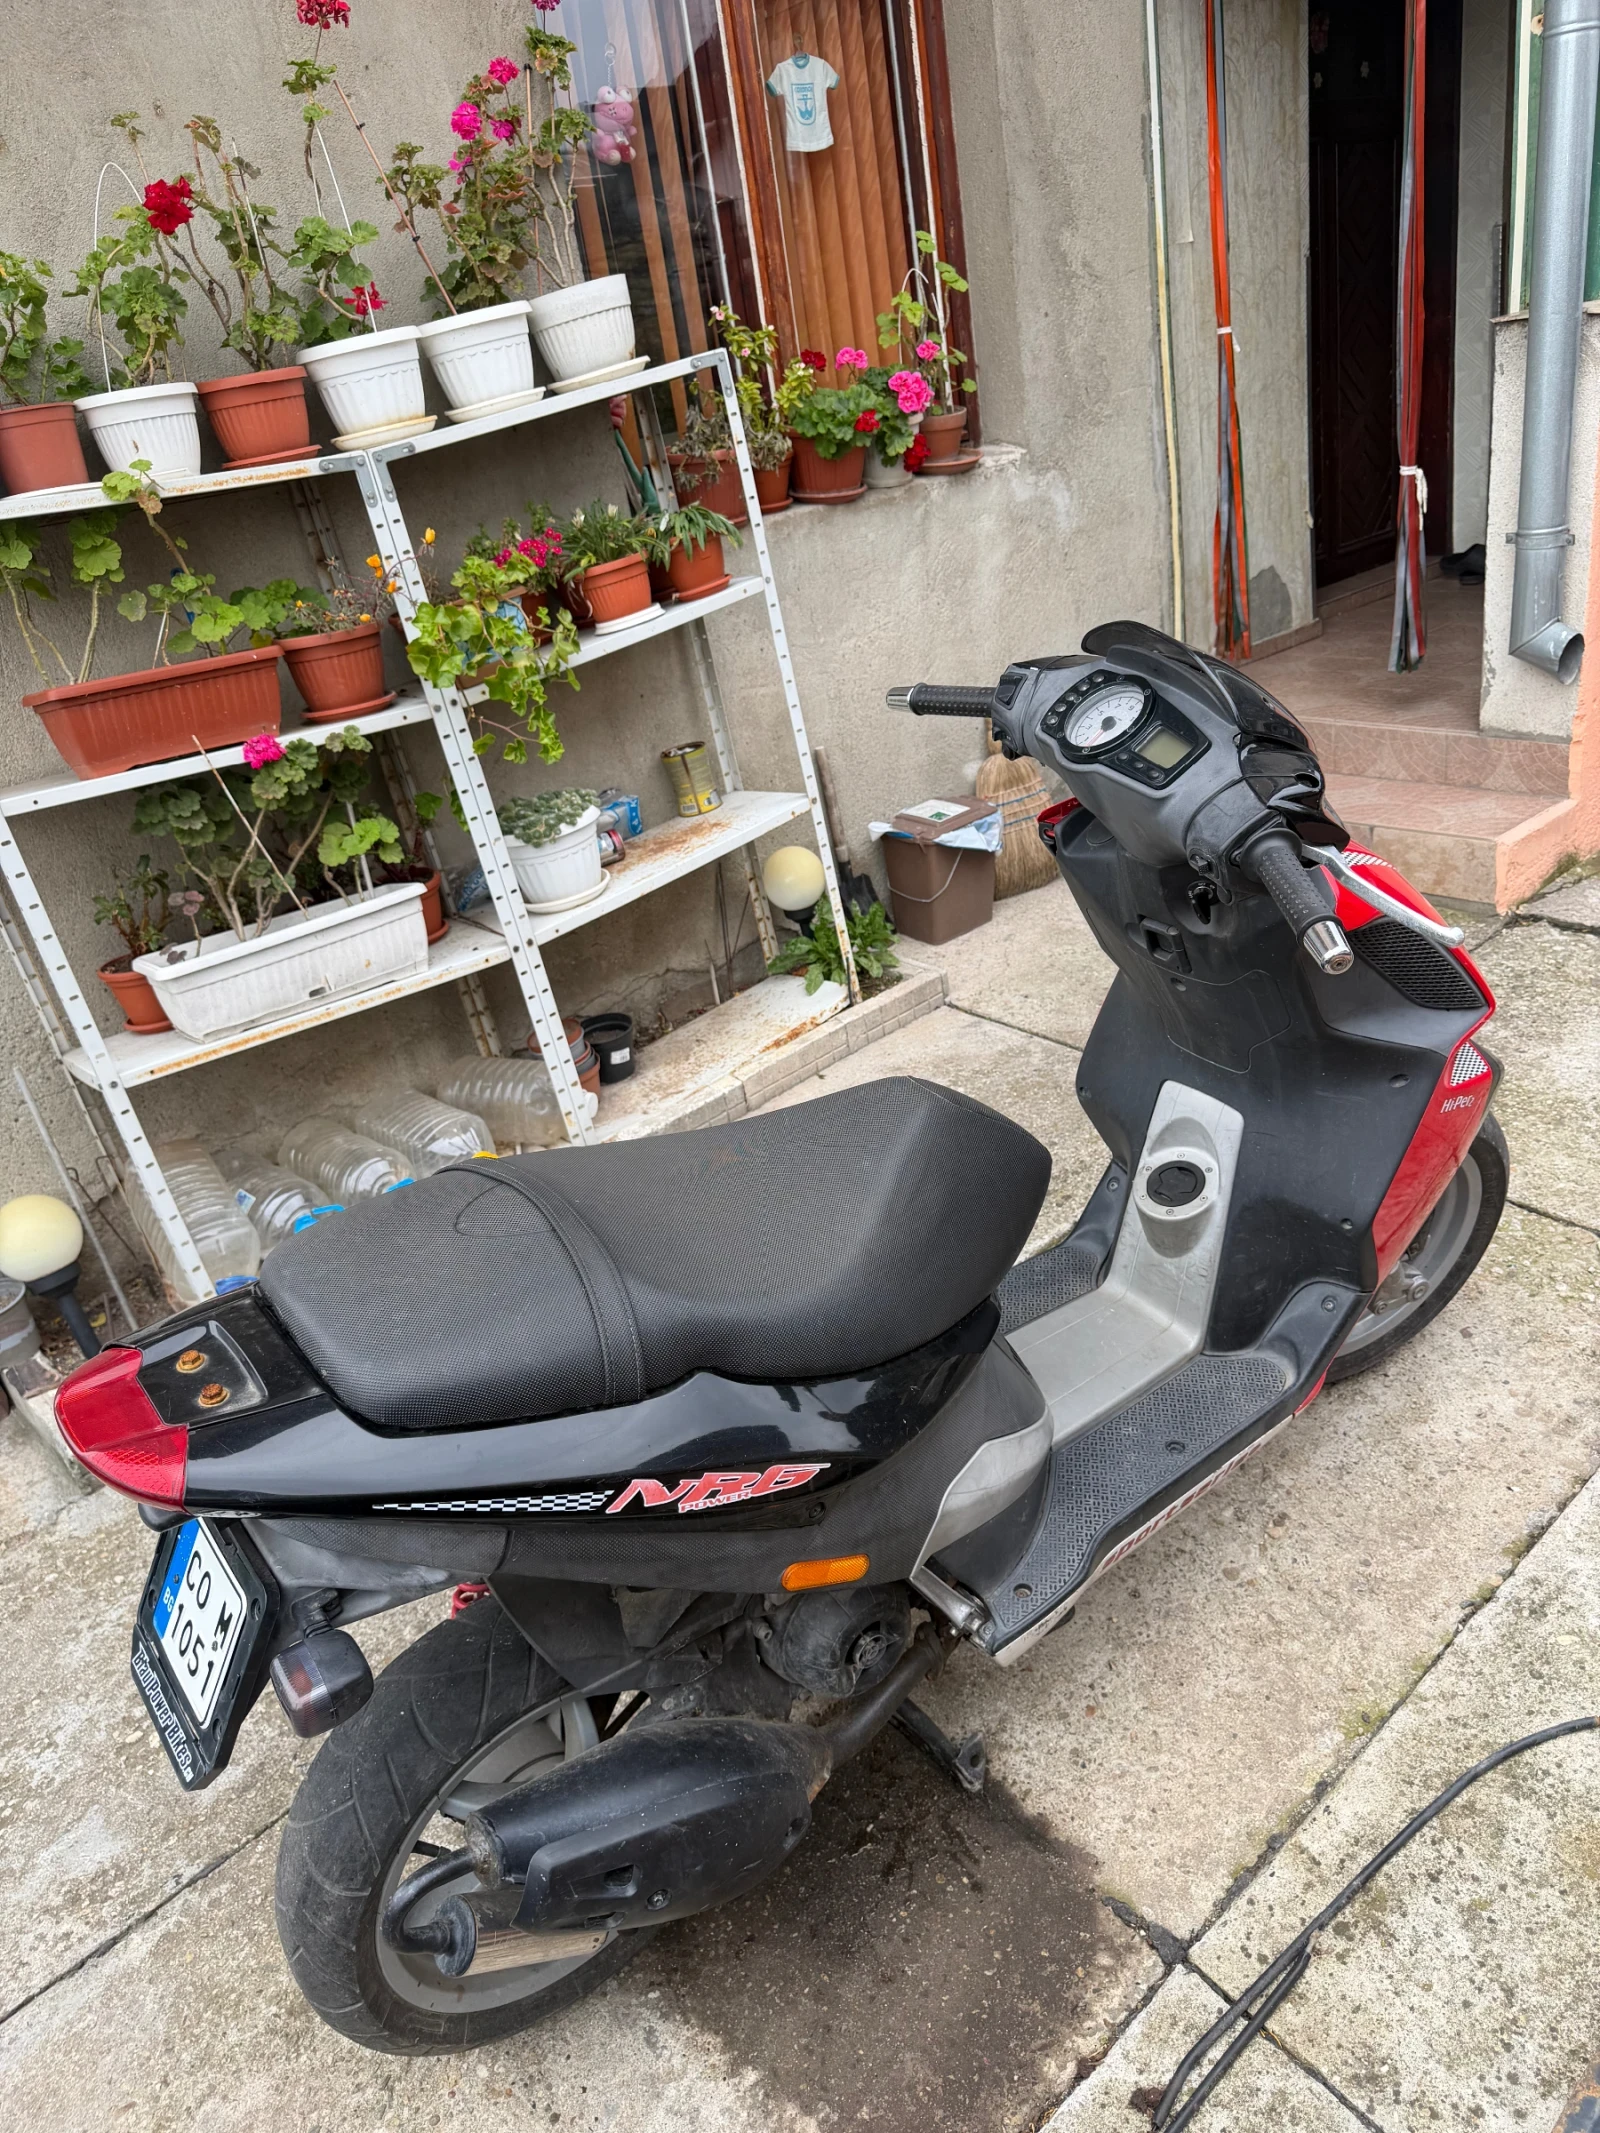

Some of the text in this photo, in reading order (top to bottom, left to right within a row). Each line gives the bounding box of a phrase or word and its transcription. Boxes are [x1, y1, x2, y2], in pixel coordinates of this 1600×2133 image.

[606, 1463, 832, 1514] NRG
[678, 1489, 753, 1514] POWER
[162, 1586, 175, 1613] BG
[186, 1550, 233, 1650] CO M
[171, 1603, 214, 1698] 1051
